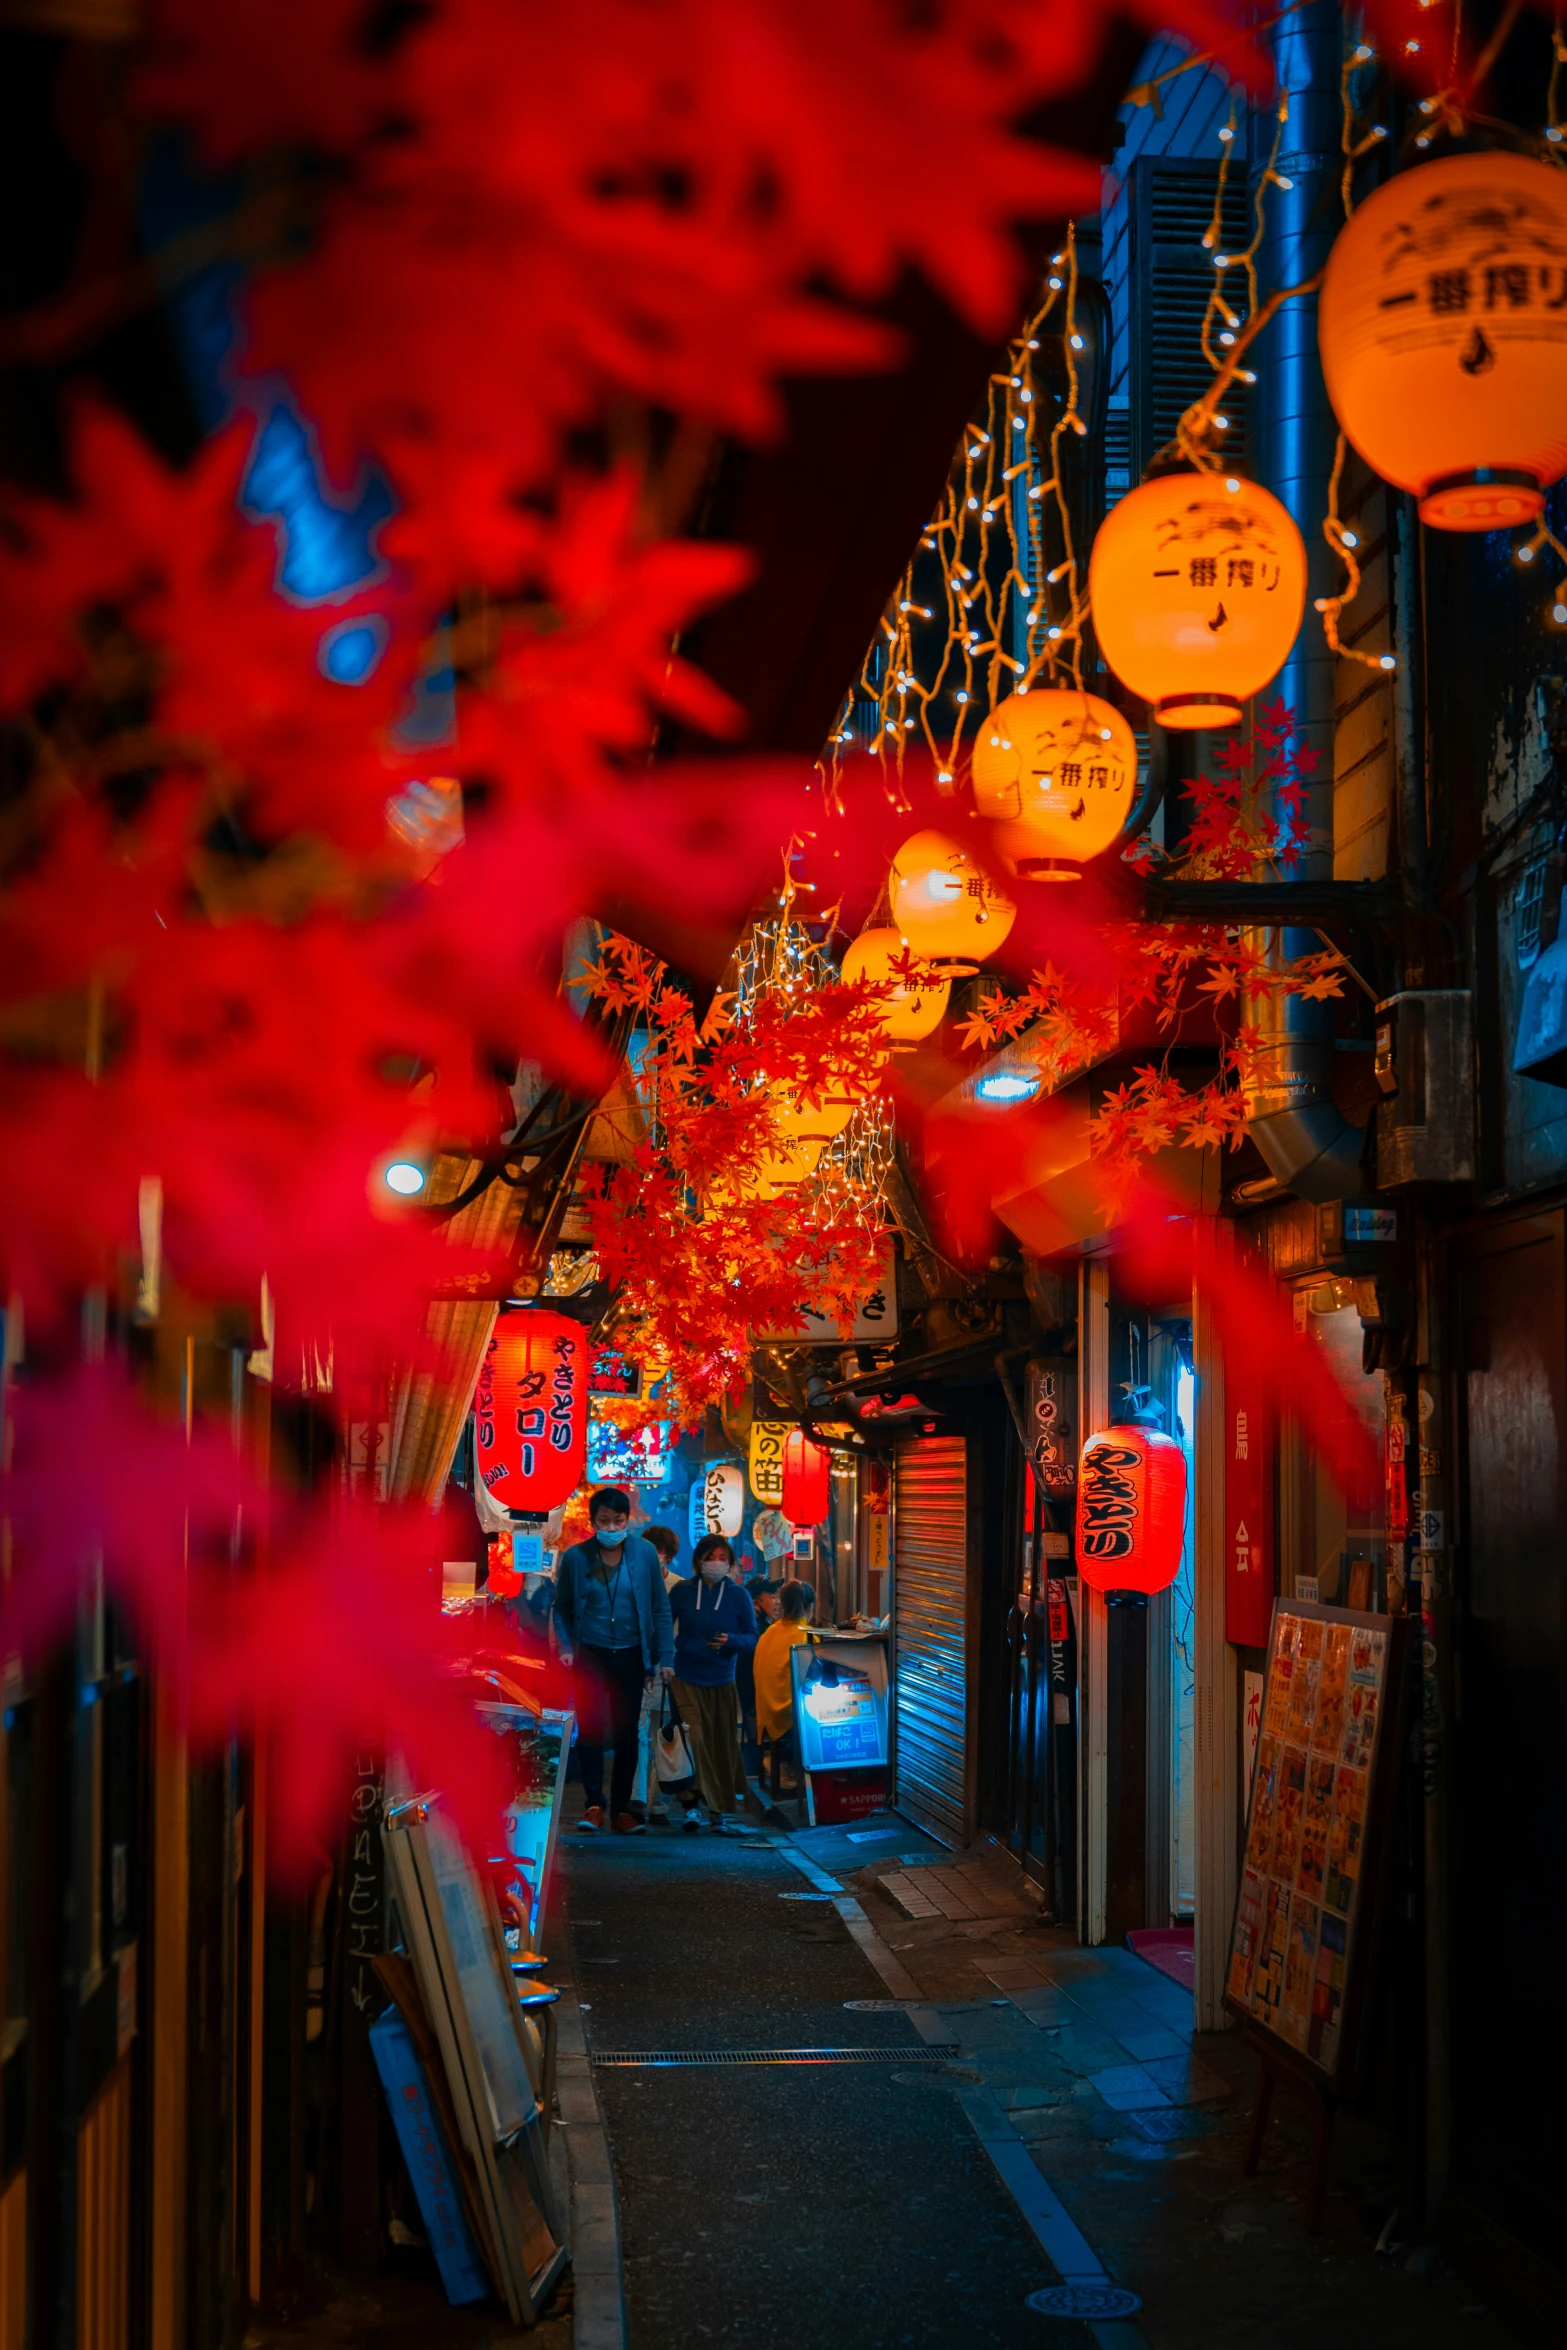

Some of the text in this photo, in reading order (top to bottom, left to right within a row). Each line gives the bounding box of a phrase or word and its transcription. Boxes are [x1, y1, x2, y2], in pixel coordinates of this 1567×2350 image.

[1153, 557, 1280, 592] 一番搾り
[1031, 762, 1125, 792] 一番搾り
[549, 1335, 577, 1453] やきとり
[516, 1369, 547, 1478] タロー
[1083, 1446, 1141, 1559] やきとり
[822, 1727, 853, 1739] たばこ
[849, 1792, 887, 1805] SAPPOR
